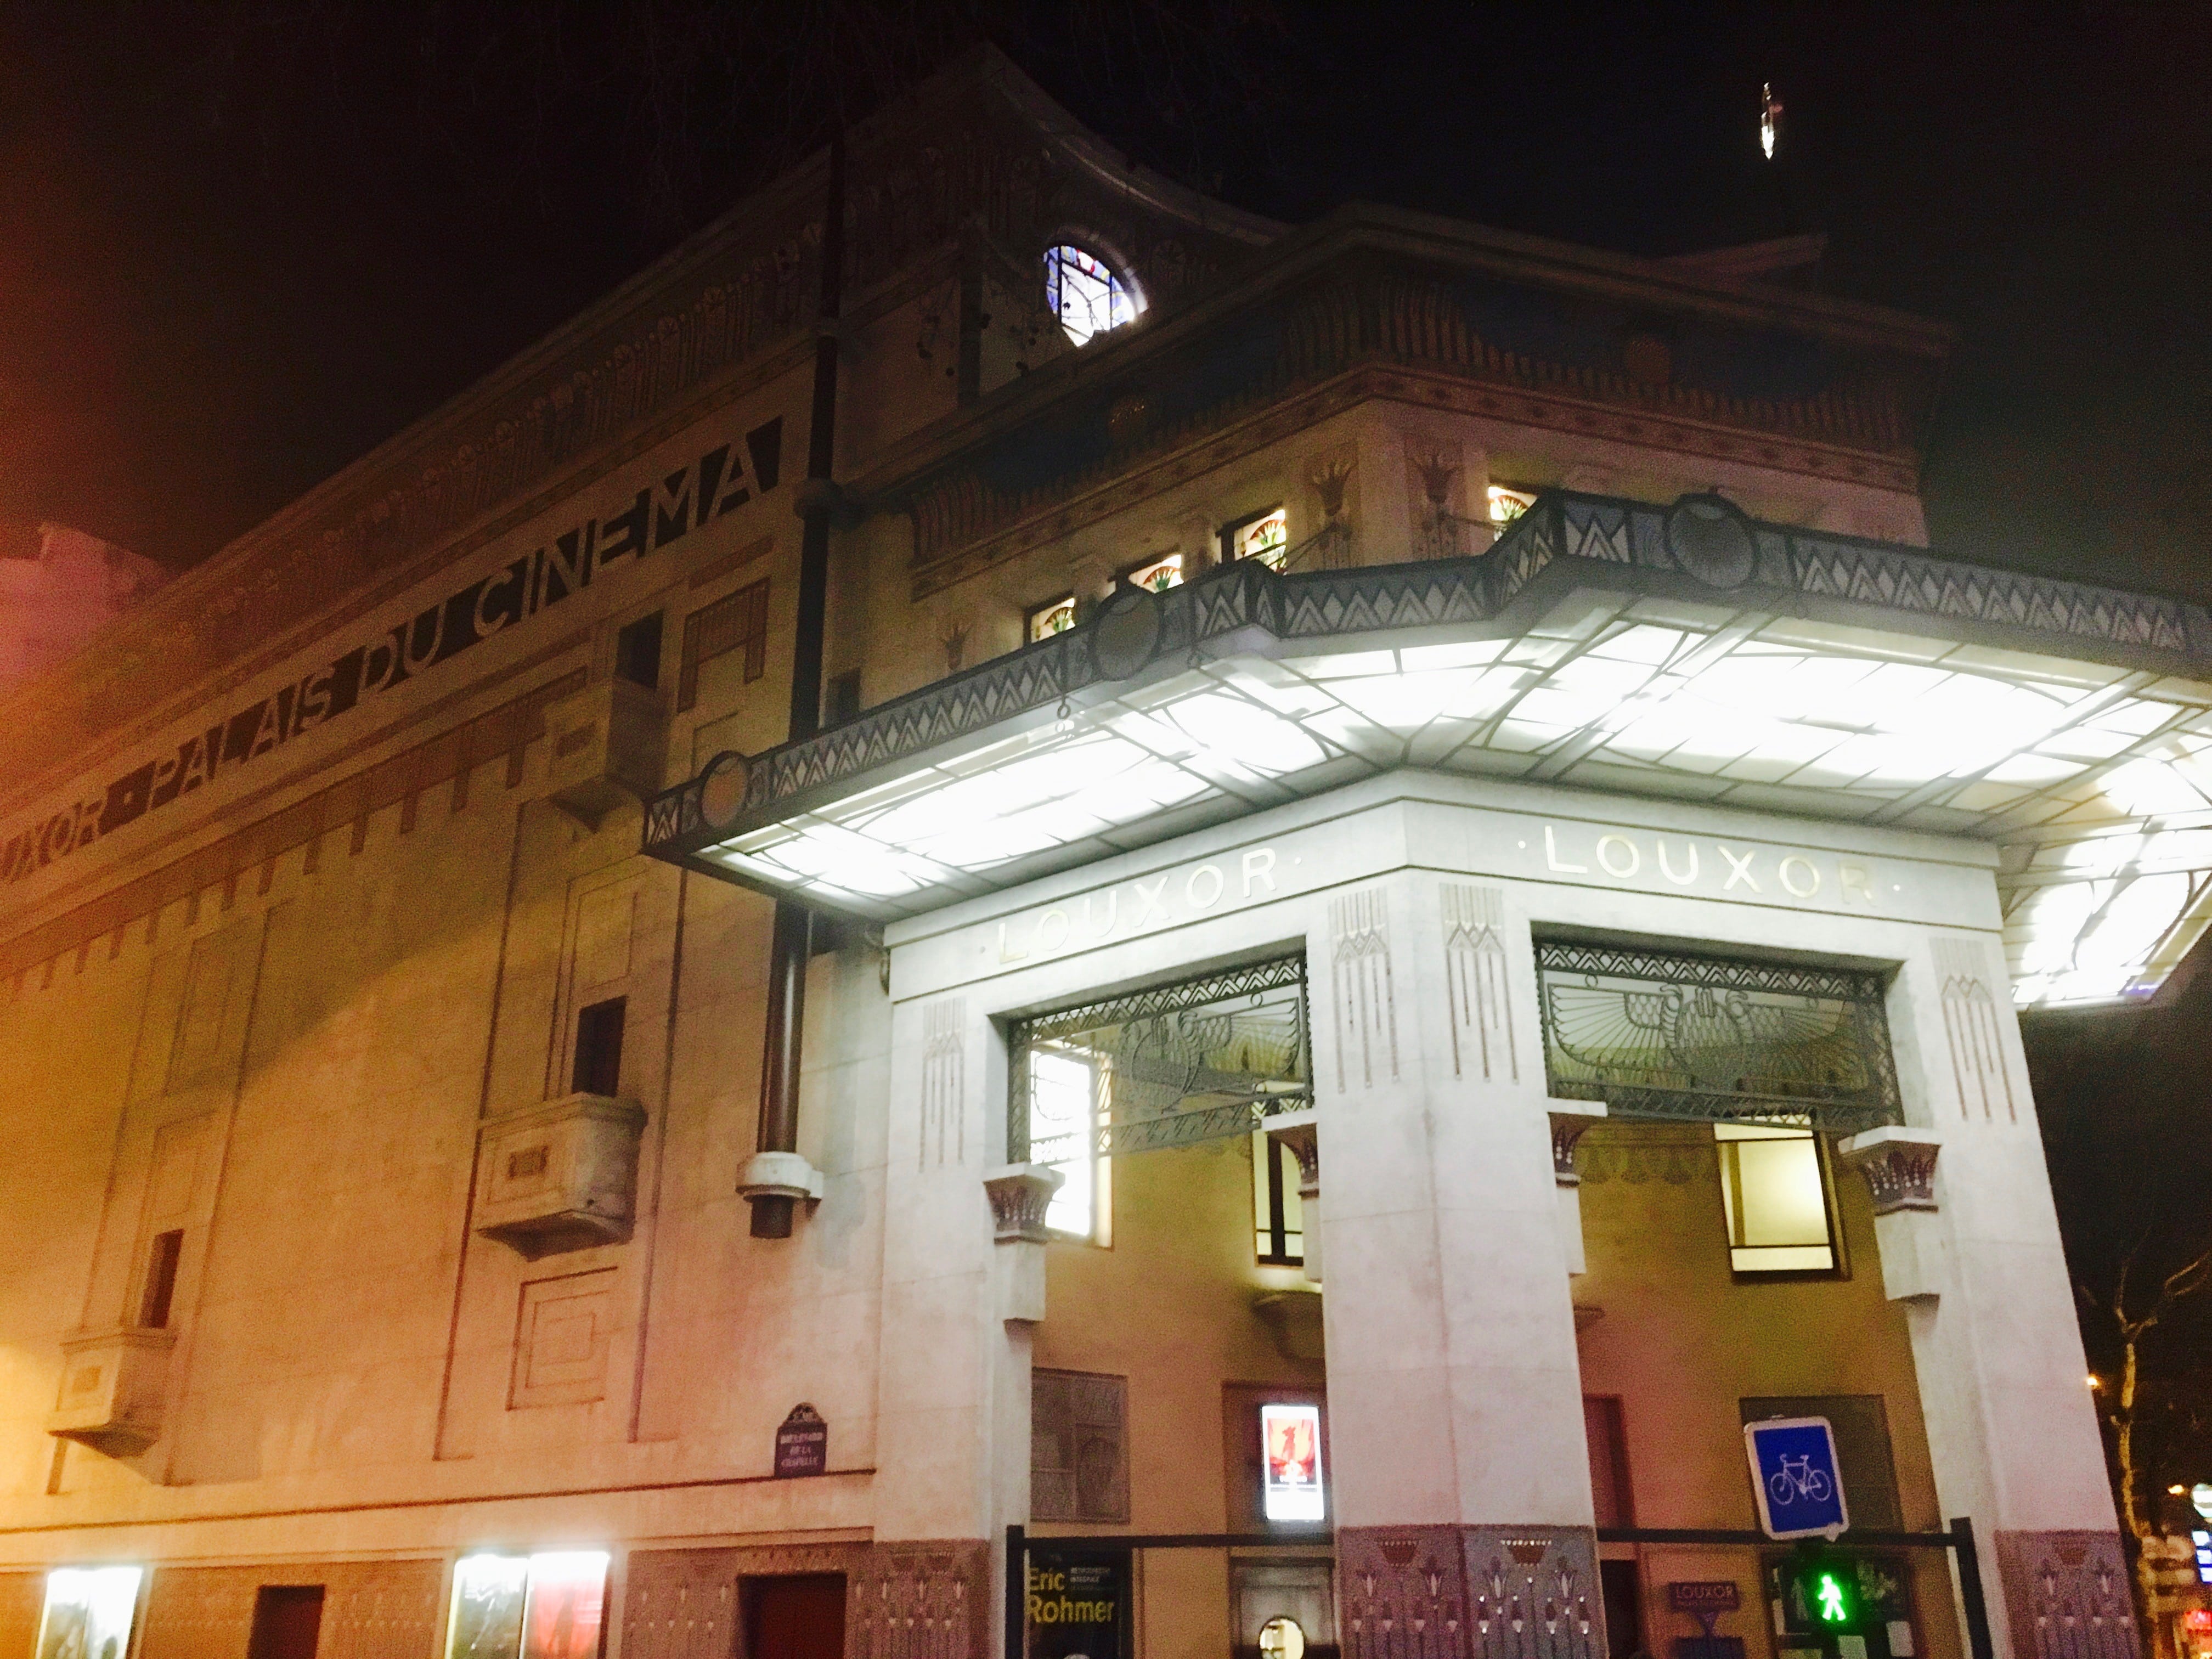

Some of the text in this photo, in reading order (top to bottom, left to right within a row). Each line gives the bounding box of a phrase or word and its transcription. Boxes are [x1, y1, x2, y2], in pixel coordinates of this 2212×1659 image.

[146, 667, 332, 811] PALAIS
[359, 601, 447, 700] DU
[473, 434, 764, 639] CINEMA
[1545, 825, 1876, 906] LOUXOR
[998, 848, 1277, 964] LOUXOR
[1029, 1567, 1065, 1591] Eric
[1676, 1585, 1733, 1599] LOUXOR
[1028, 1594, 1115, 1623] Rohmer
